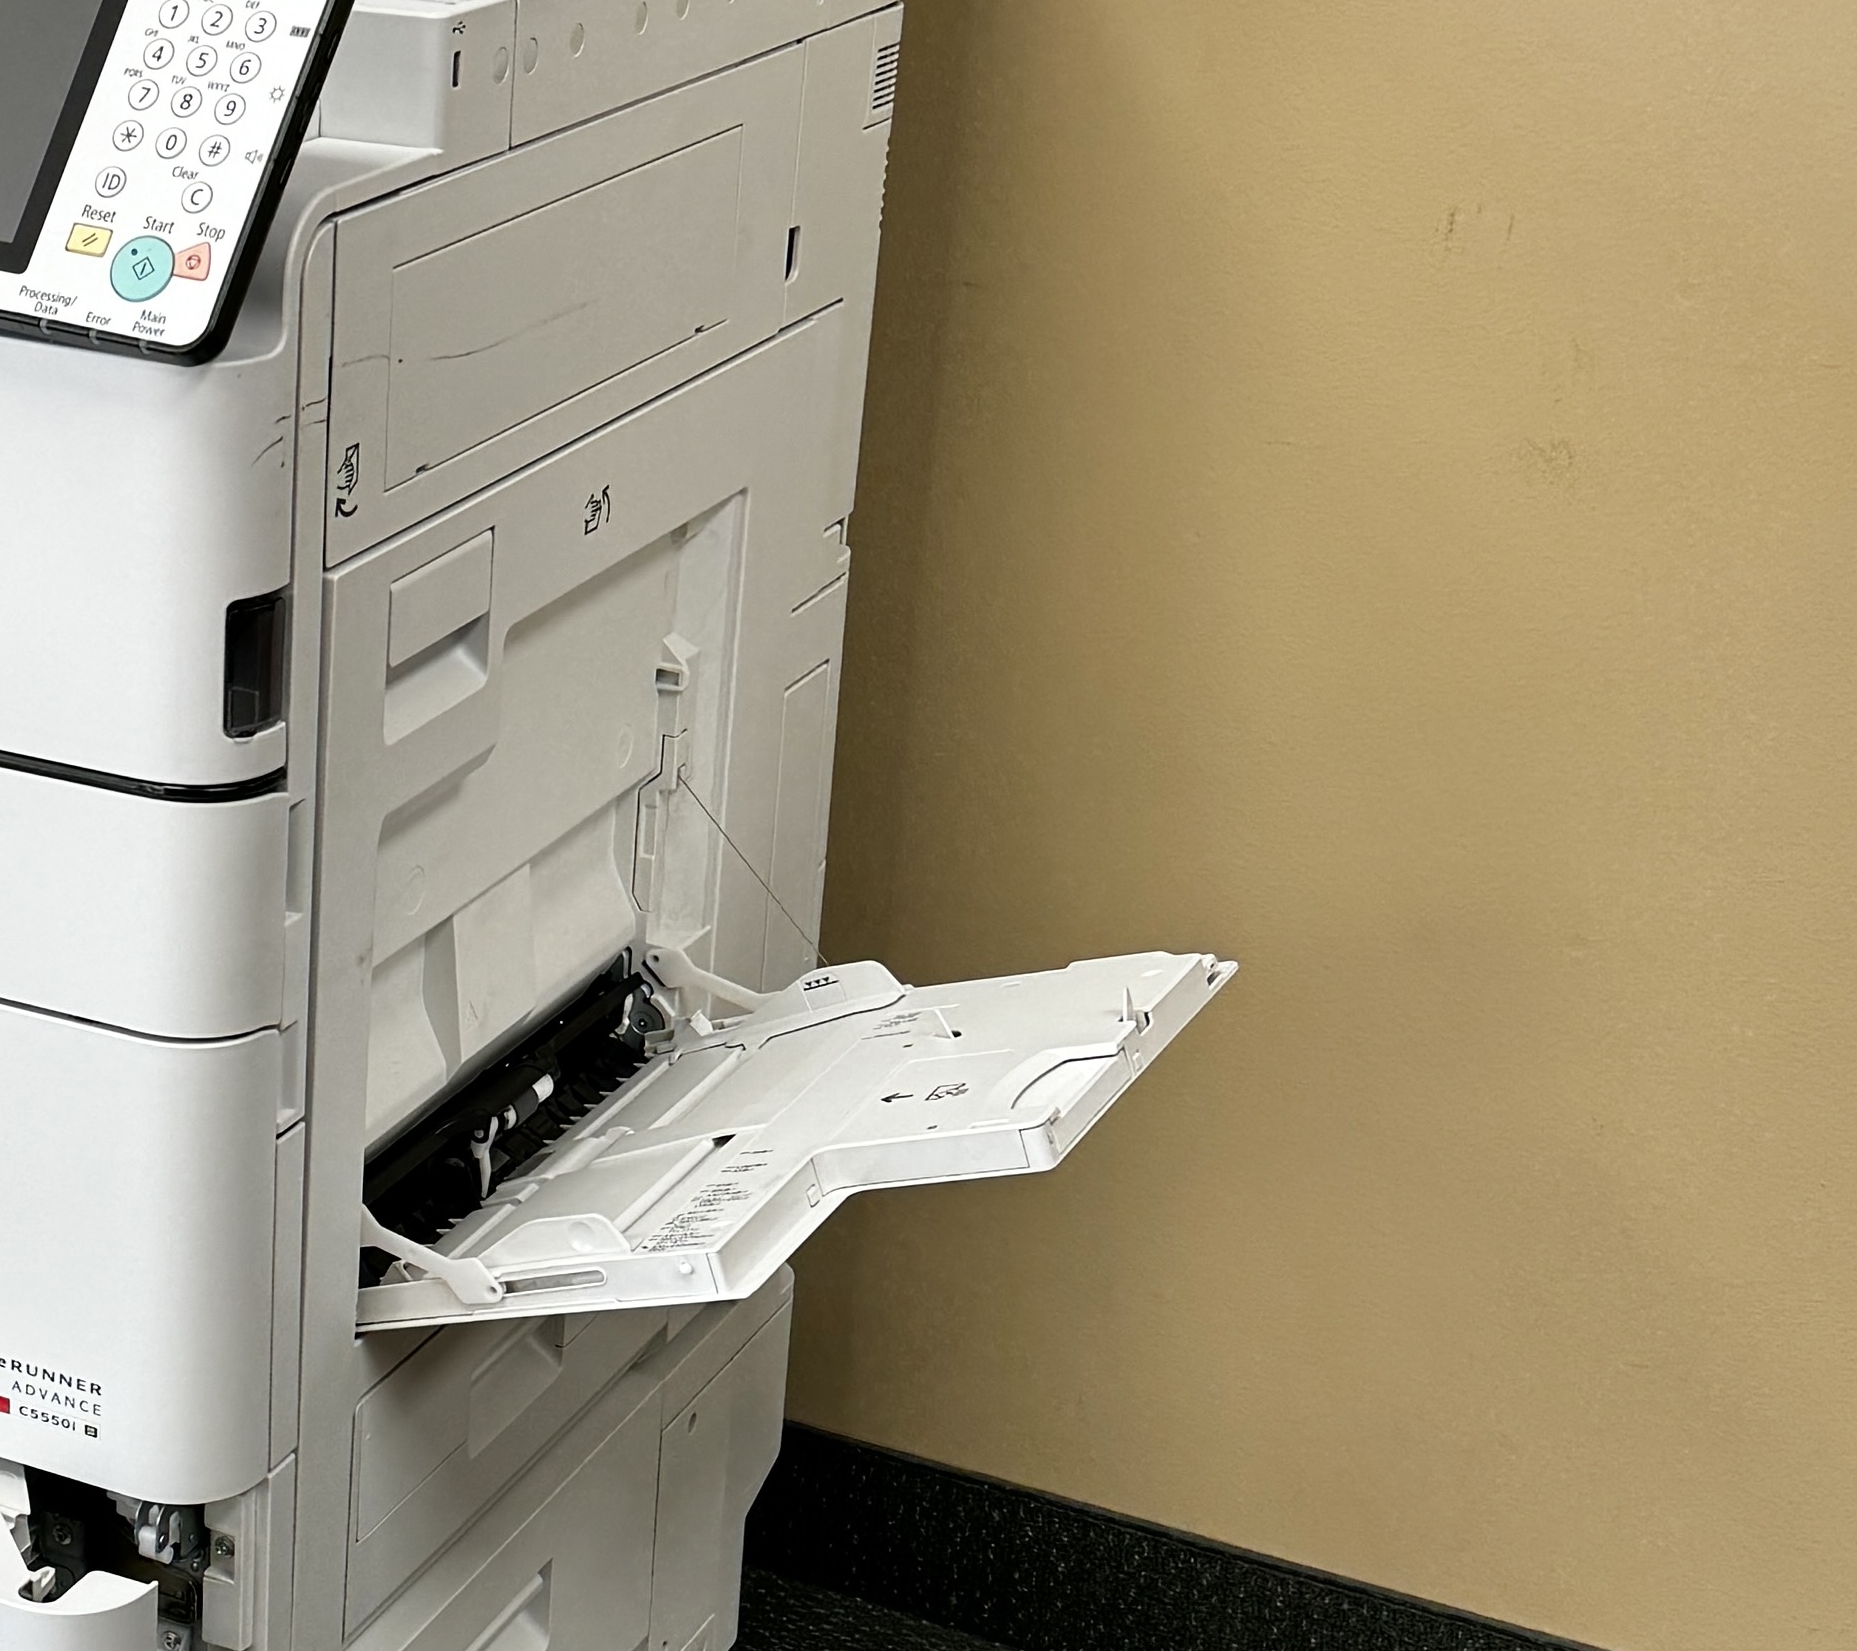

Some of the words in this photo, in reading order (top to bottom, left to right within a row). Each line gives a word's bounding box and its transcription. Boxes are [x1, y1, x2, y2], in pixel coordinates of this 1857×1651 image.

[170, 5, 179, 22] 1
[209, 10, 223, 27] 2
[253, 17, 267, 35] 3
[152, 46, 164, 62] 4
[195, 52, 209, 69] 5
[238, 59, 252, 76] 6
[138, 86, 151, 103] 7
[179, 93, 193, 110] 8
[223, 100, 237, 117] 9
[165, 134, 177, 151] 0
[102, 172, 121, 190] ID
[172, 165, 199, 180] Clear
[190, 188, 204, 206] C
[81, 204, 116, 224] Reset
[143, 215, 175, 234] Start
[196, 221, 226, 243] Stop
[19, 285, 78, 307] Processing/
[33, 302, 59, 316] Data
[140, 309, 167, 325] Main
[85, 311, 111, 326] Error
[132, 323, 166, 337] Power
[11, 1380, 102, 1417] ADVANCE
